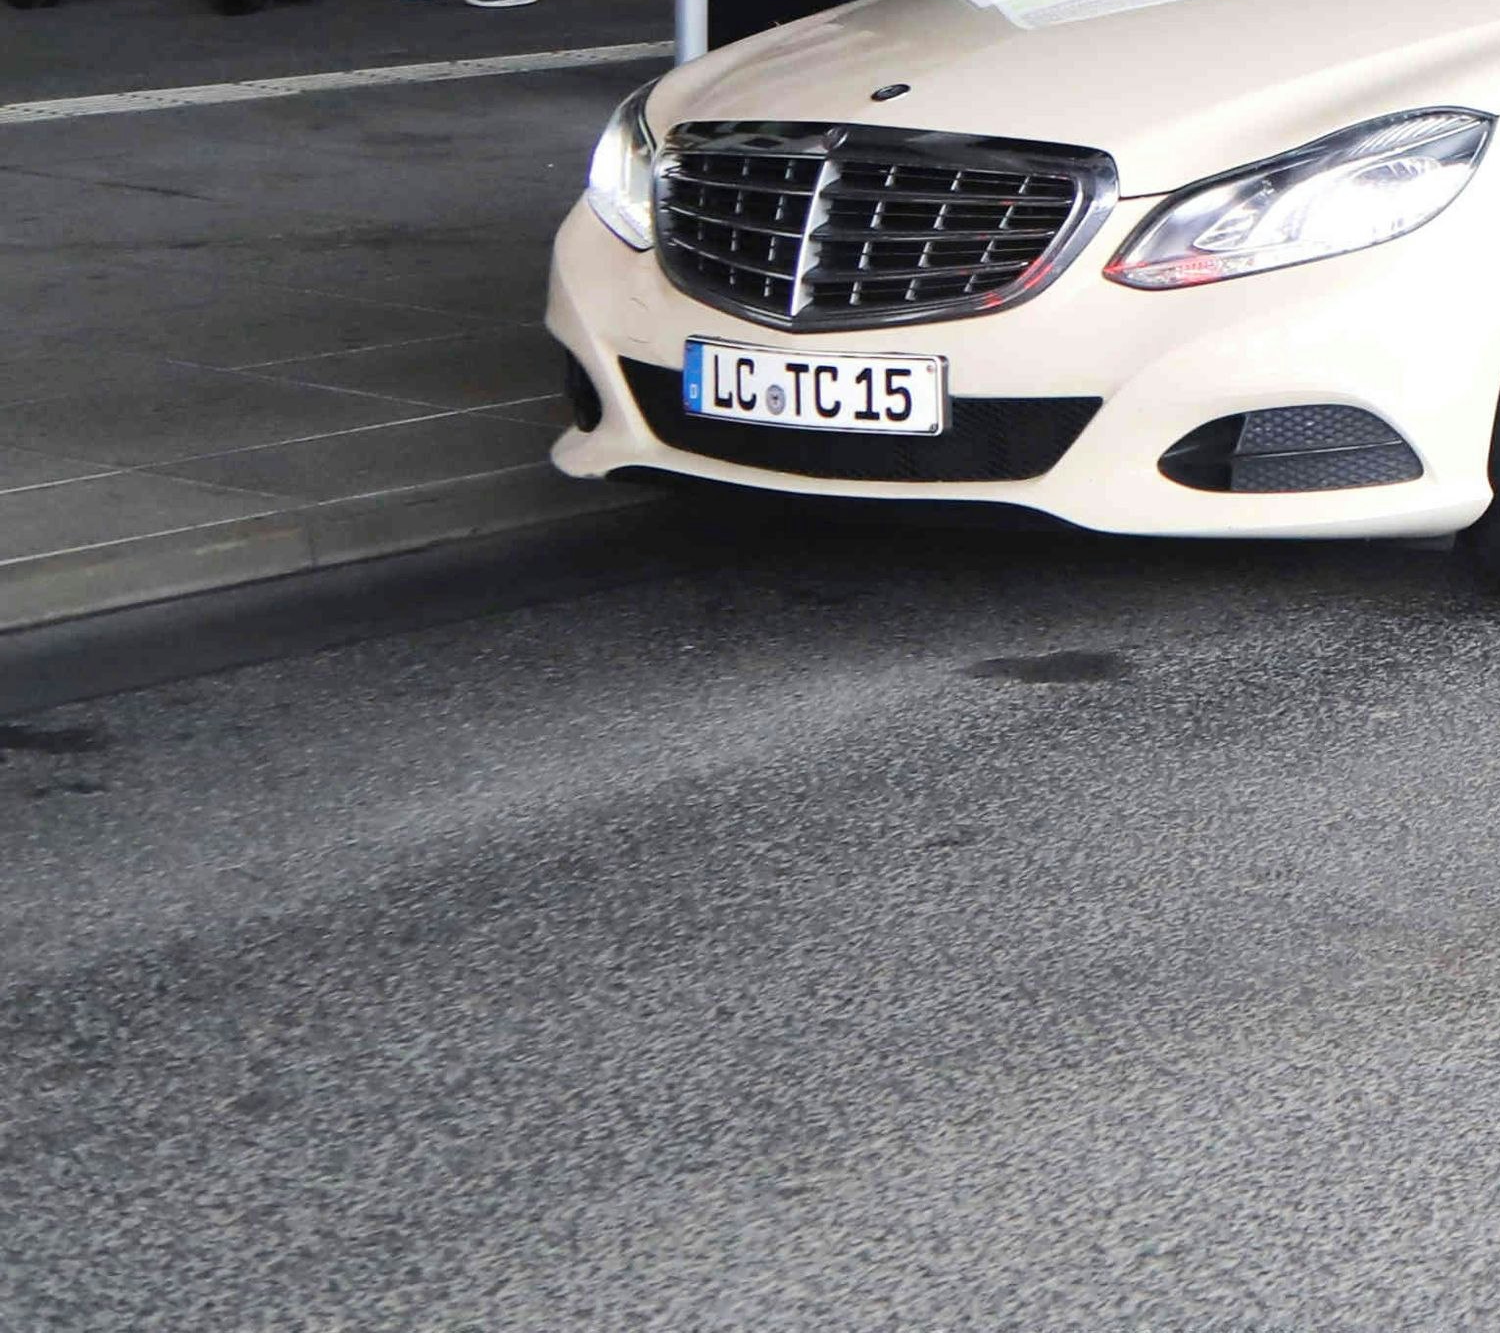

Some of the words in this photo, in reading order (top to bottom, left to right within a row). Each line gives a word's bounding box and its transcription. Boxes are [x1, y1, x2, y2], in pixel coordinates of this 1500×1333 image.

[713, 354, 757, 411] LC
[785, 362, 841, 418] TC
[854, 367, 912, 421] 15
